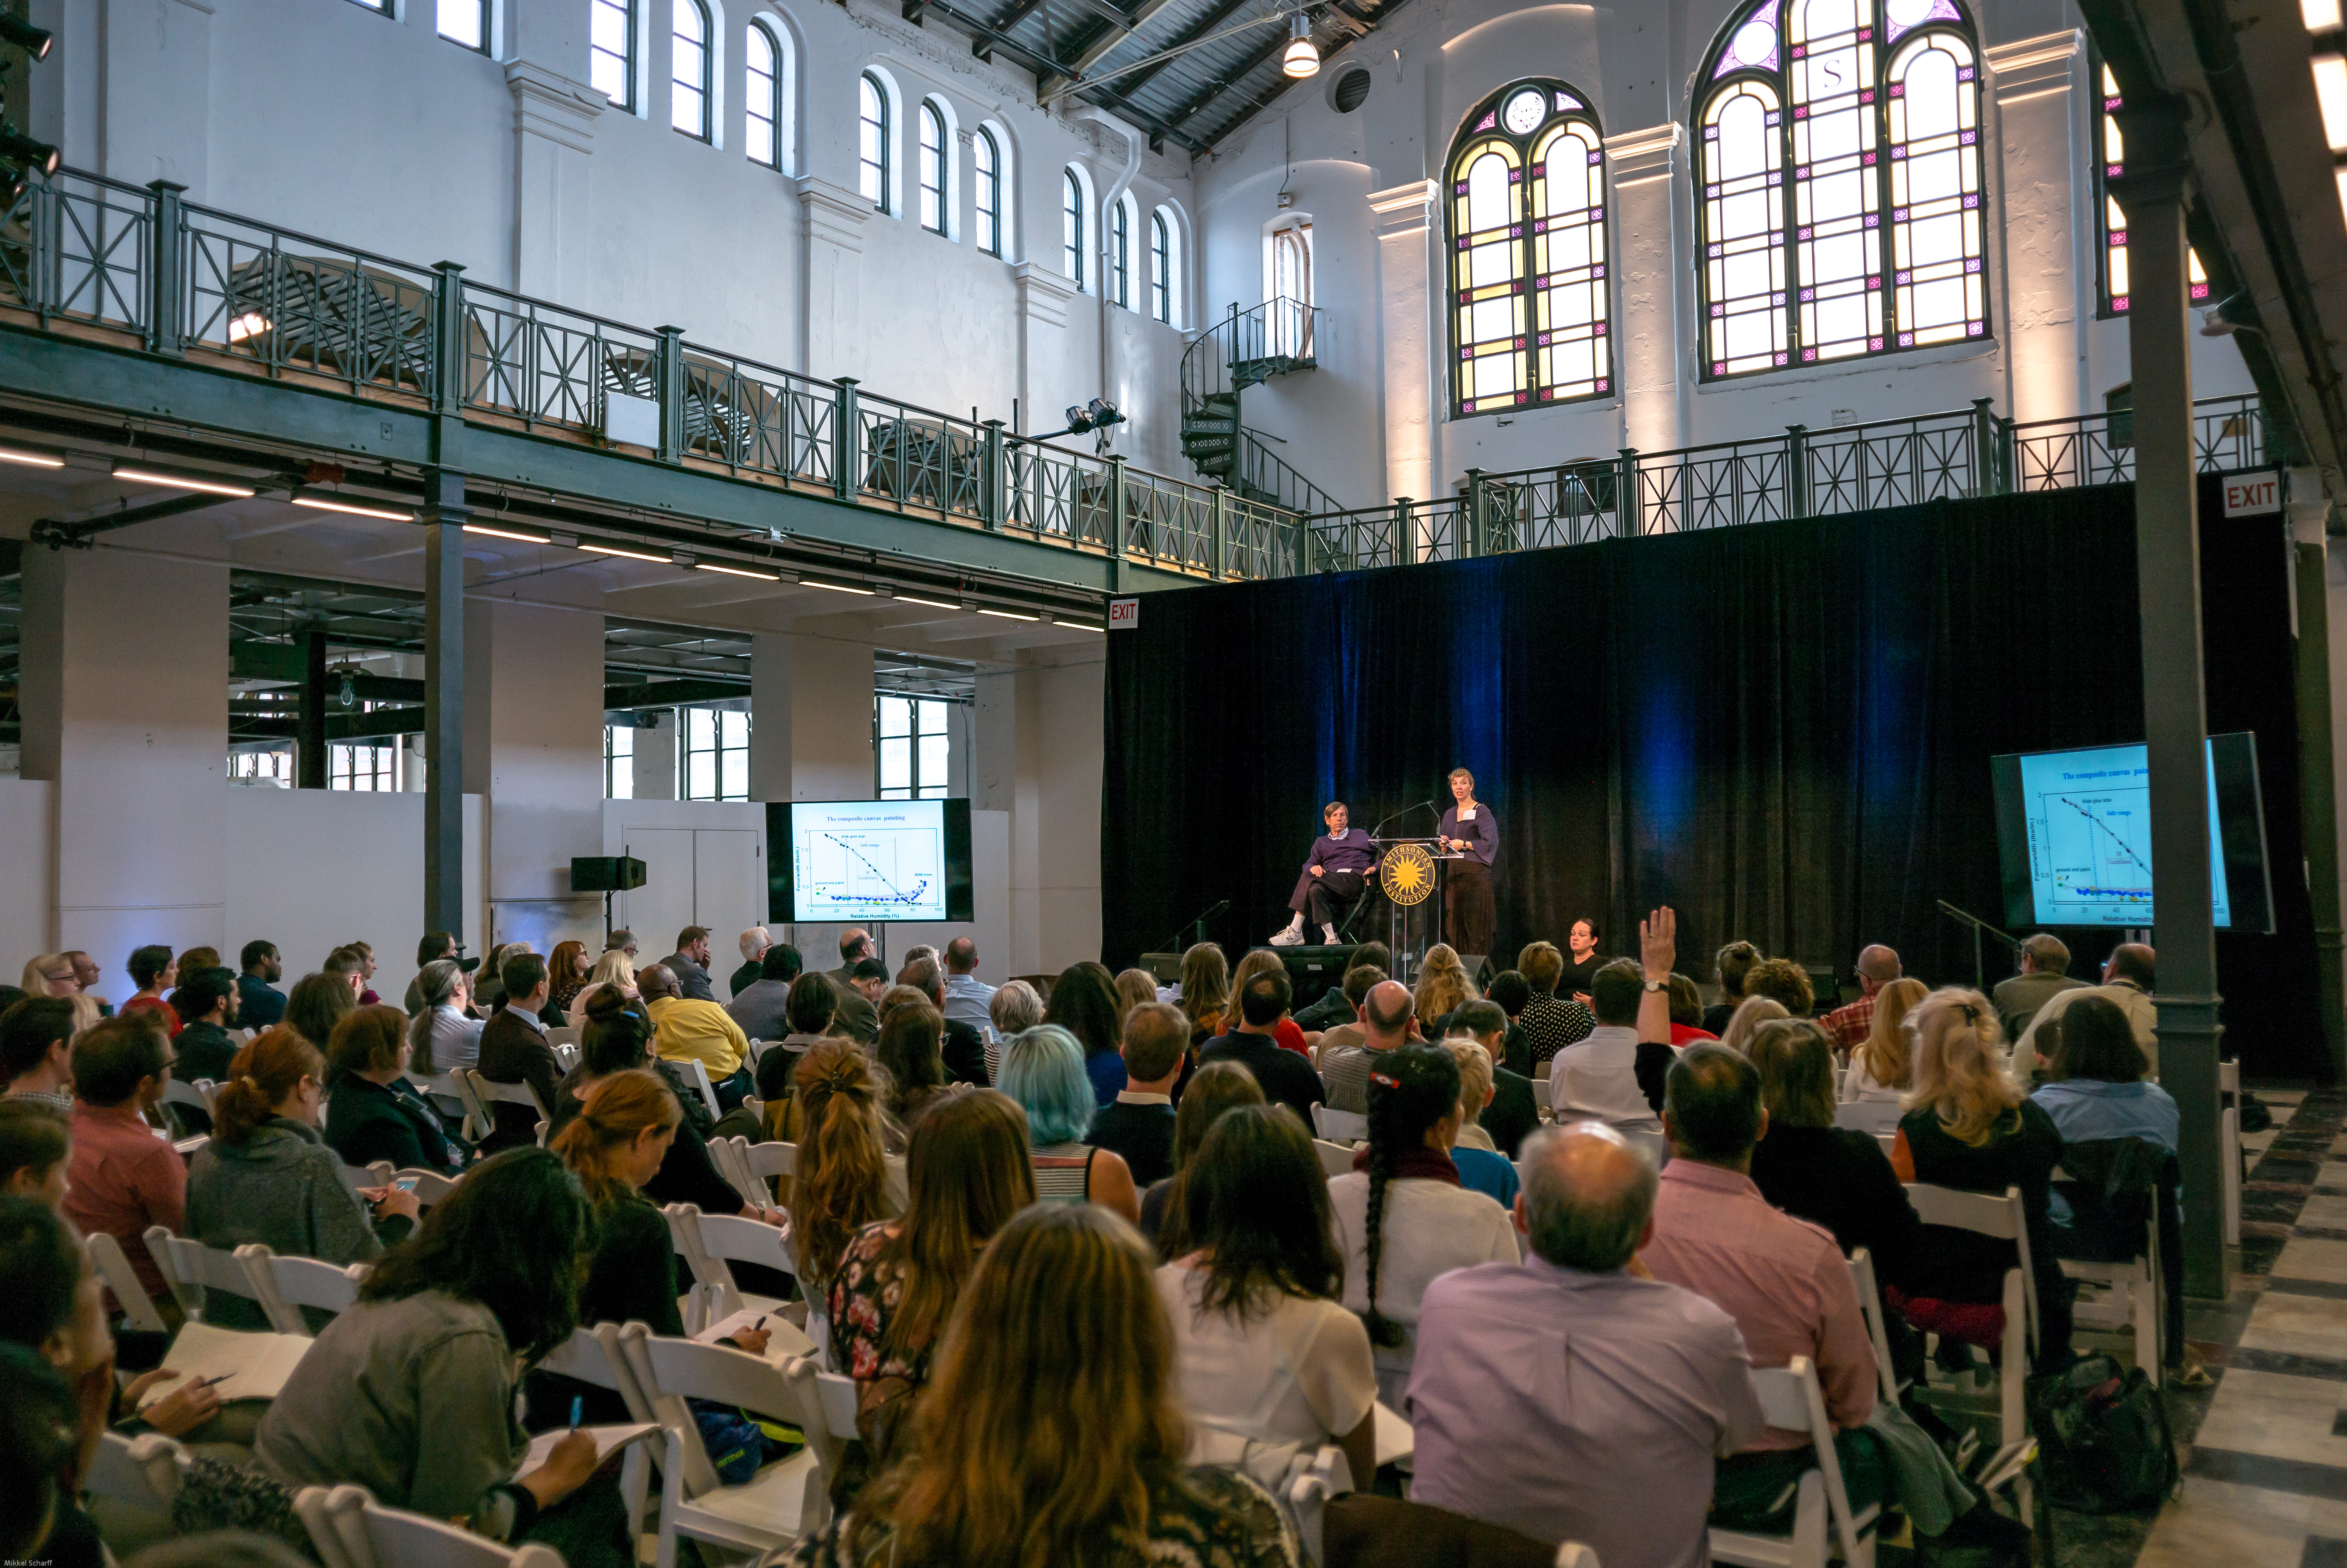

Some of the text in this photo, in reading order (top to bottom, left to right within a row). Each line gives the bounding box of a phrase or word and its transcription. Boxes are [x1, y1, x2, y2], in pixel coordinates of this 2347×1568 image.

[2228, 482, 2275, 508] EXIT
[1112, 603, 1136, 620] EXIT
[2076, 770, 2107, 780] composite
[2134, 767, 2149, 776] pain
[1384, 846, 1432, 868] SMITHSONIAN
[1384, 883, 1431, 903] INSTITUTION
